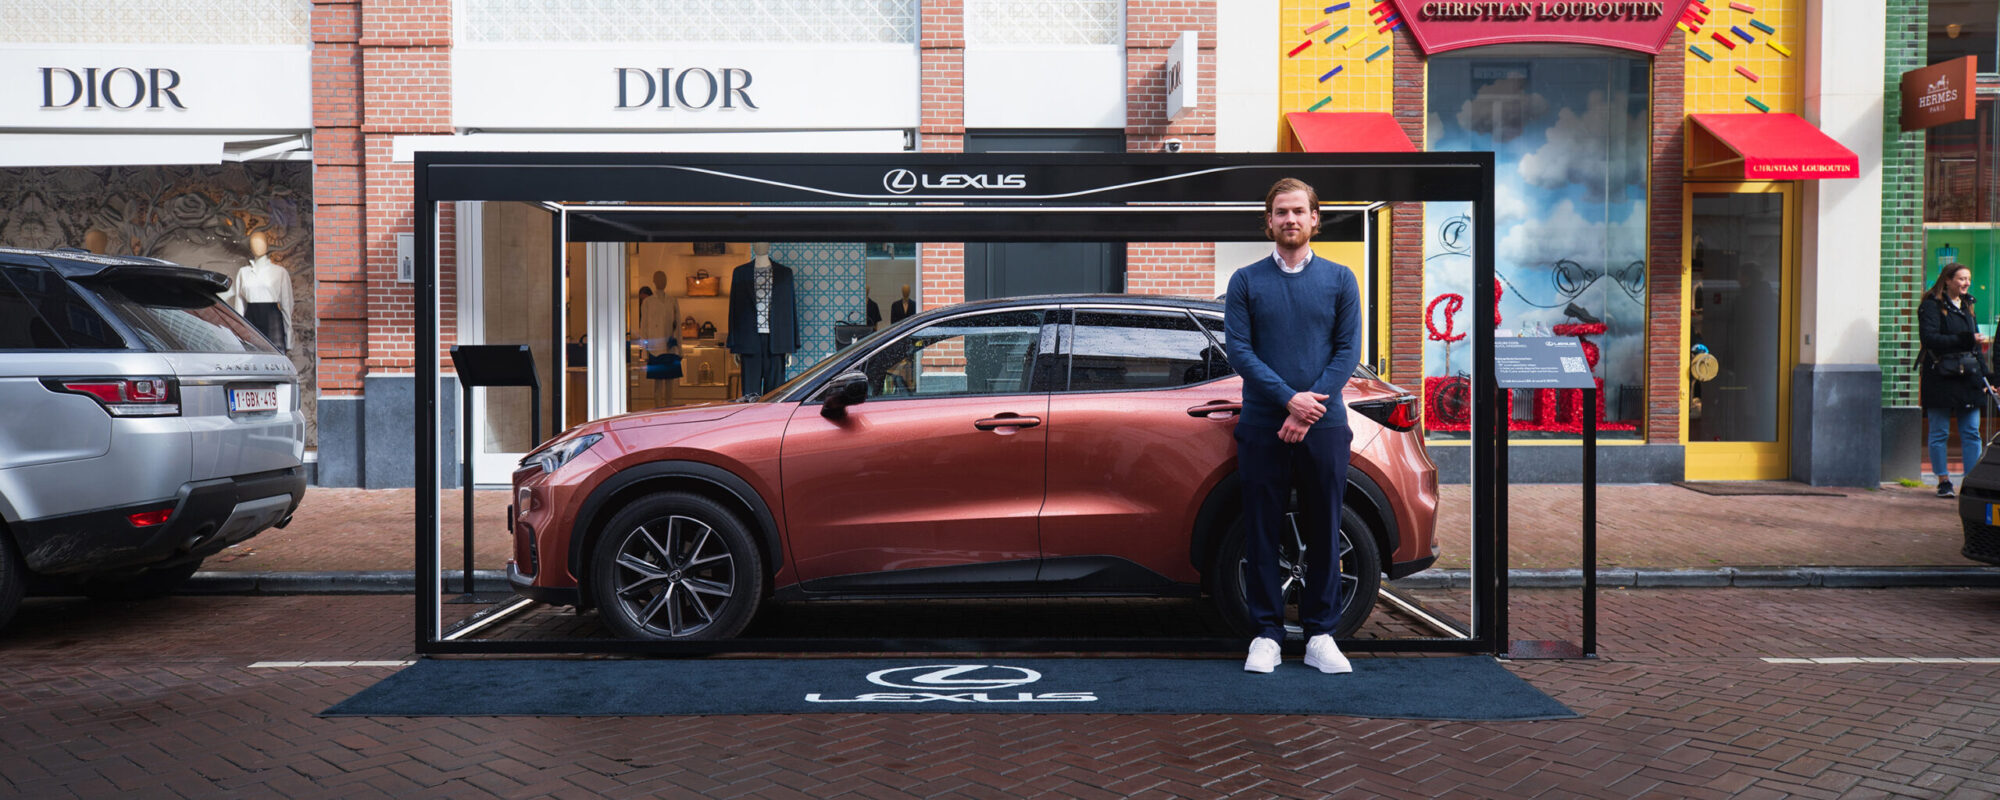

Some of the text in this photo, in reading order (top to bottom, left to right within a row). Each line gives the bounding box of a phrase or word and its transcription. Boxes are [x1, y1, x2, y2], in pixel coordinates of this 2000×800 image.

[1422, 1, 1664, 17] CHRISTIAN LOUBOUTIN
[1168, 61, 1181, 95] DIOR
[38, 67, 188, 109] DIOR
[614, 67, 760, 109] DIOR
[1753, 164, 1851, 172] CHRISTIAN LOUBOUTIN
[922, 174, 1027, 189] LEXUS
[804, 692, 1099, 702] LEXUS
